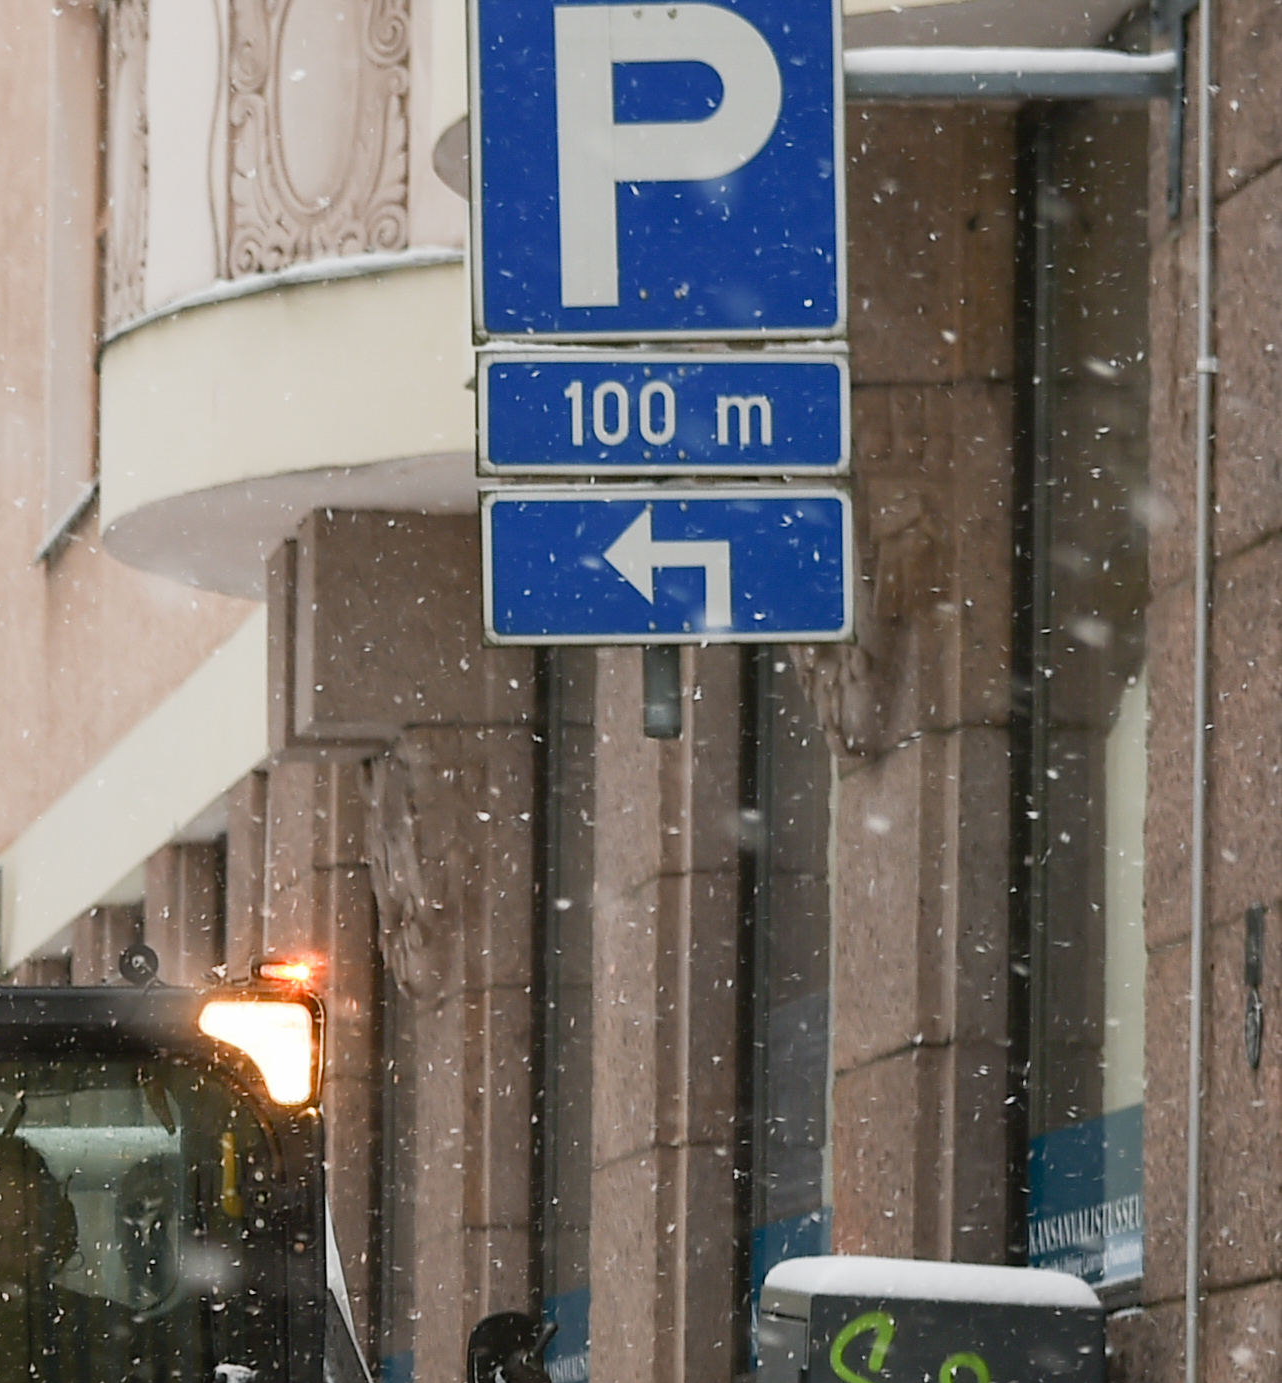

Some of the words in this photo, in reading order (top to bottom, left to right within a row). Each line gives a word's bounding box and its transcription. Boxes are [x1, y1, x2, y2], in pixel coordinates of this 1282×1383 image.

[553, 3, 782, 308] P
[564, 380, 676, 446] 100
[716, 394, 773, 446] m
